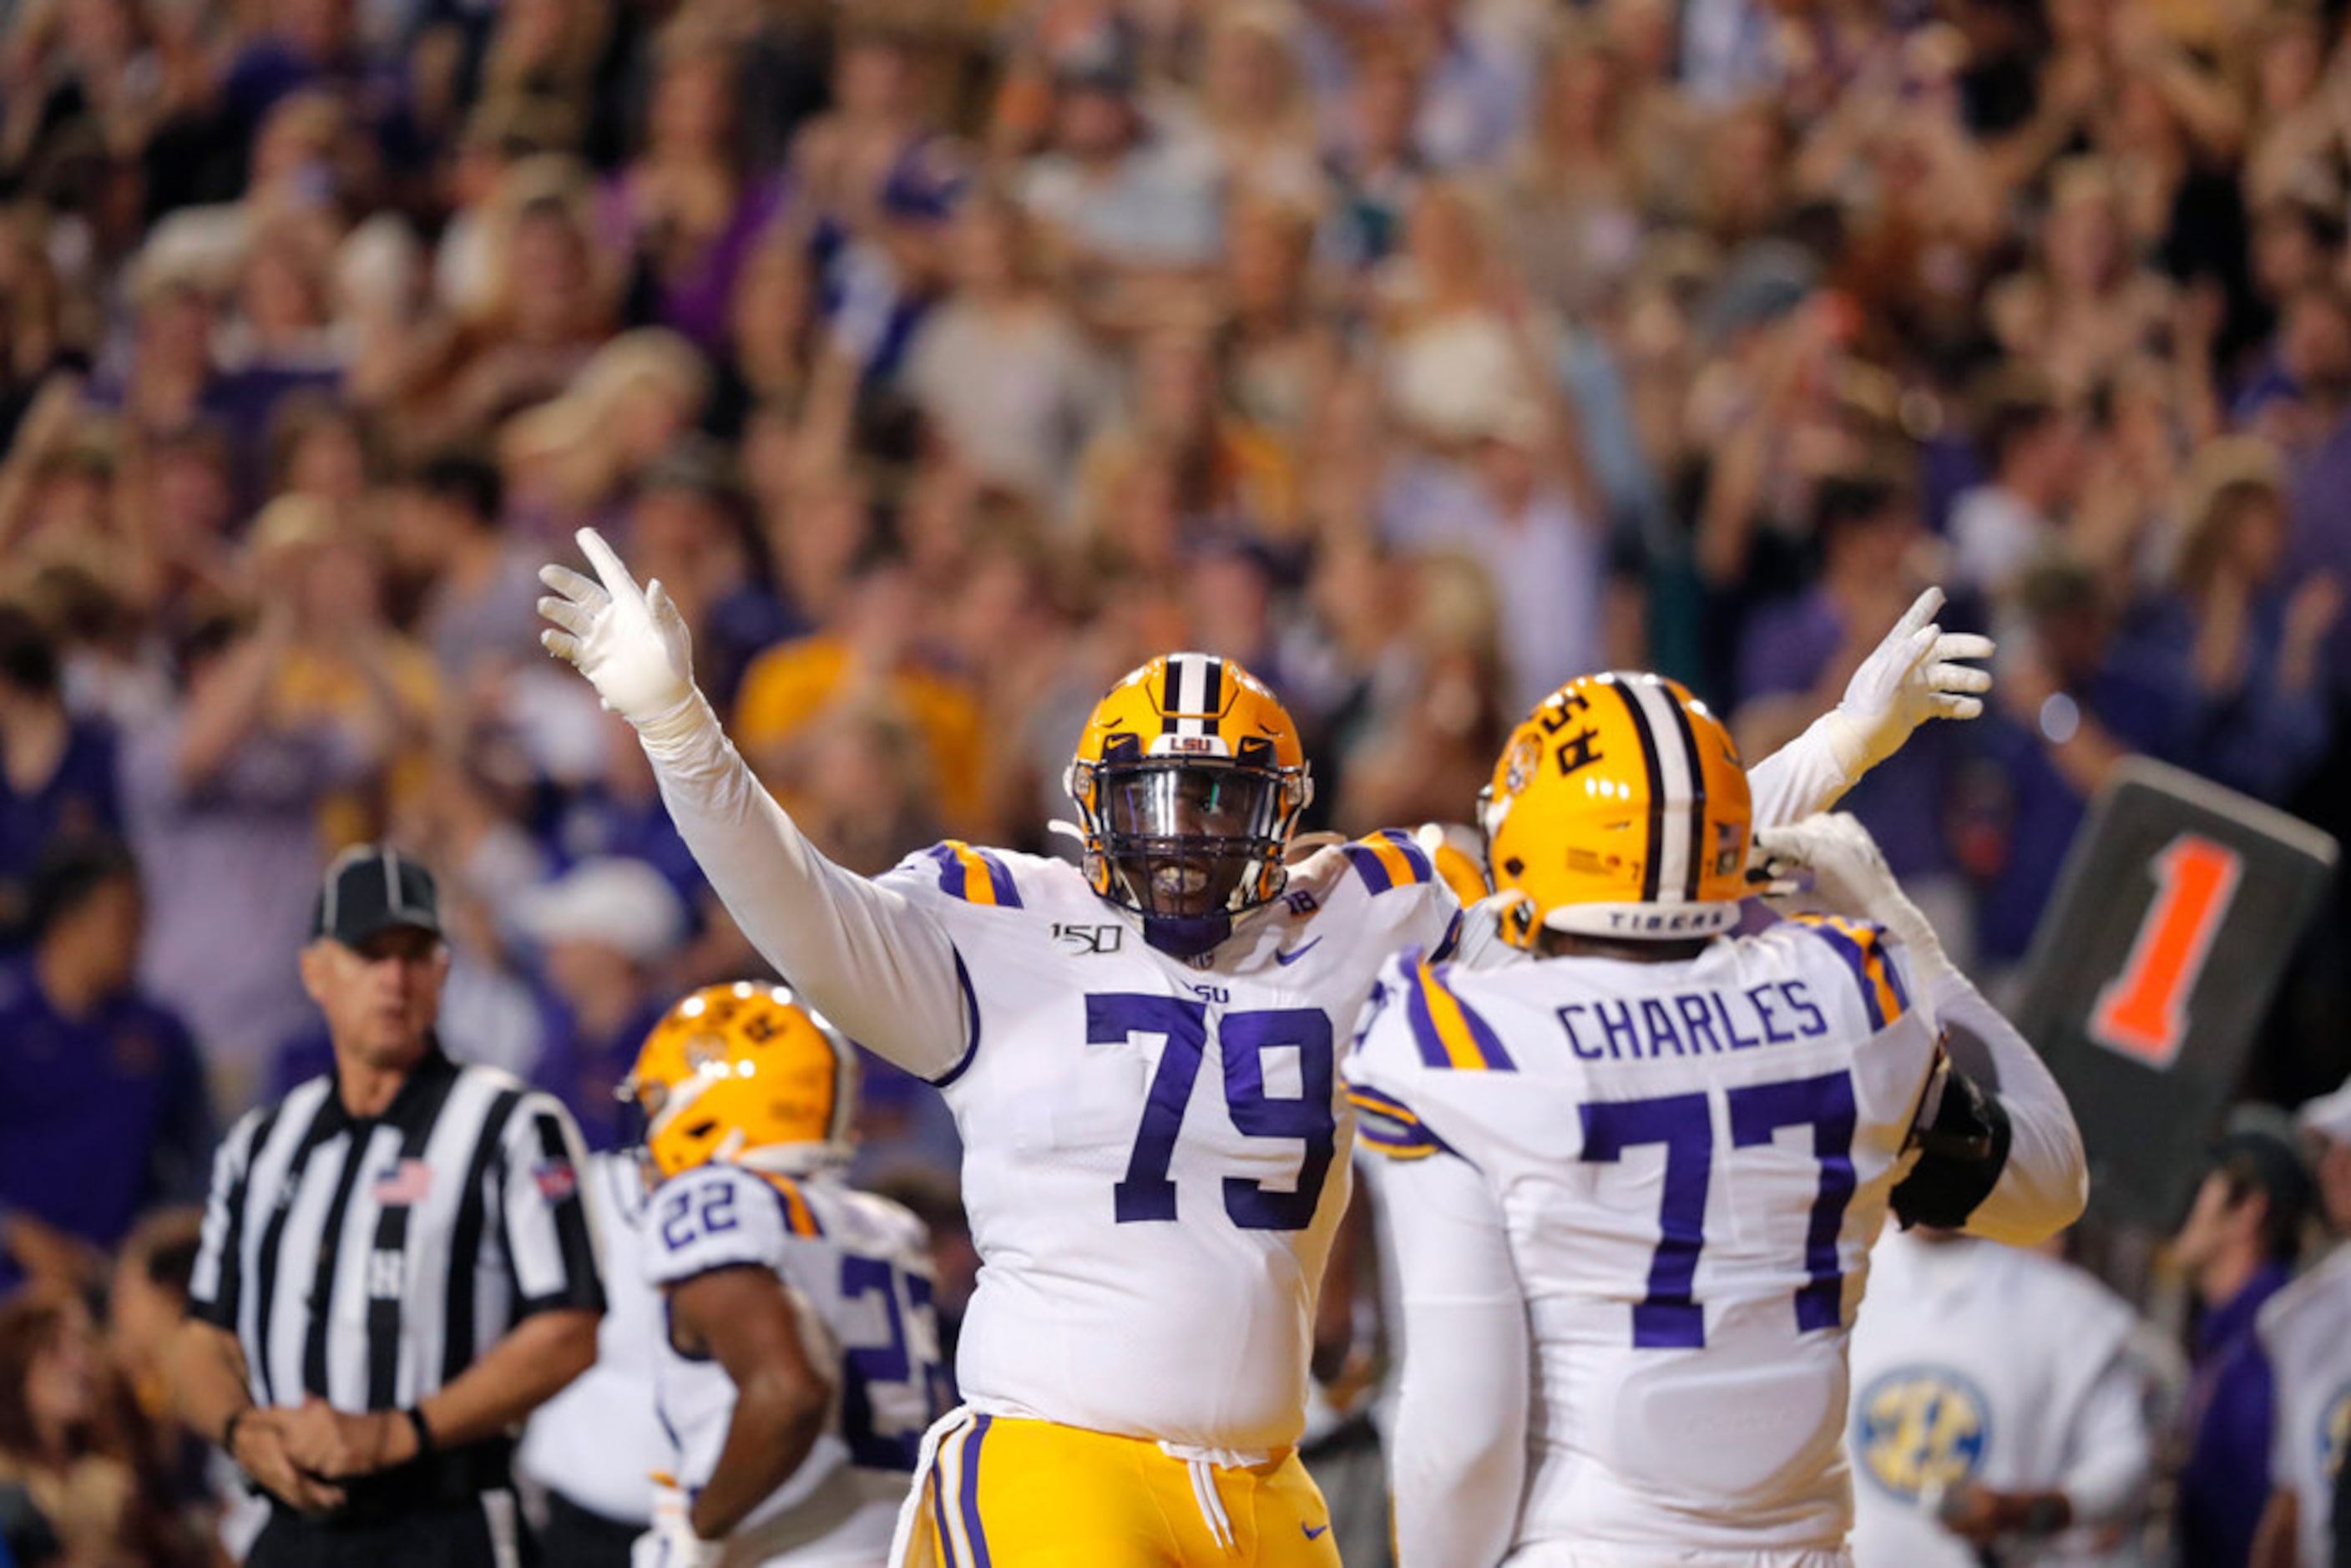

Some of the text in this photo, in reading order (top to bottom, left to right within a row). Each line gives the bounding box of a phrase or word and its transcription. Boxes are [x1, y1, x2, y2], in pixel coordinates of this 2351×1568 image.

[1170, 737, 1211, 752] LSU
[1052, 923, 1122, 956] 150
[1610, 912, 1723, 930] TIGERS
[2091, 834, 2242, 1068] 1
[1556, 979, 1828, 1060] CHARLES
[1084, 993, 1336, 1231] 79
[661, 1181, 739, 1251] 22
[1577, 1070, 1857, 1348] 77
